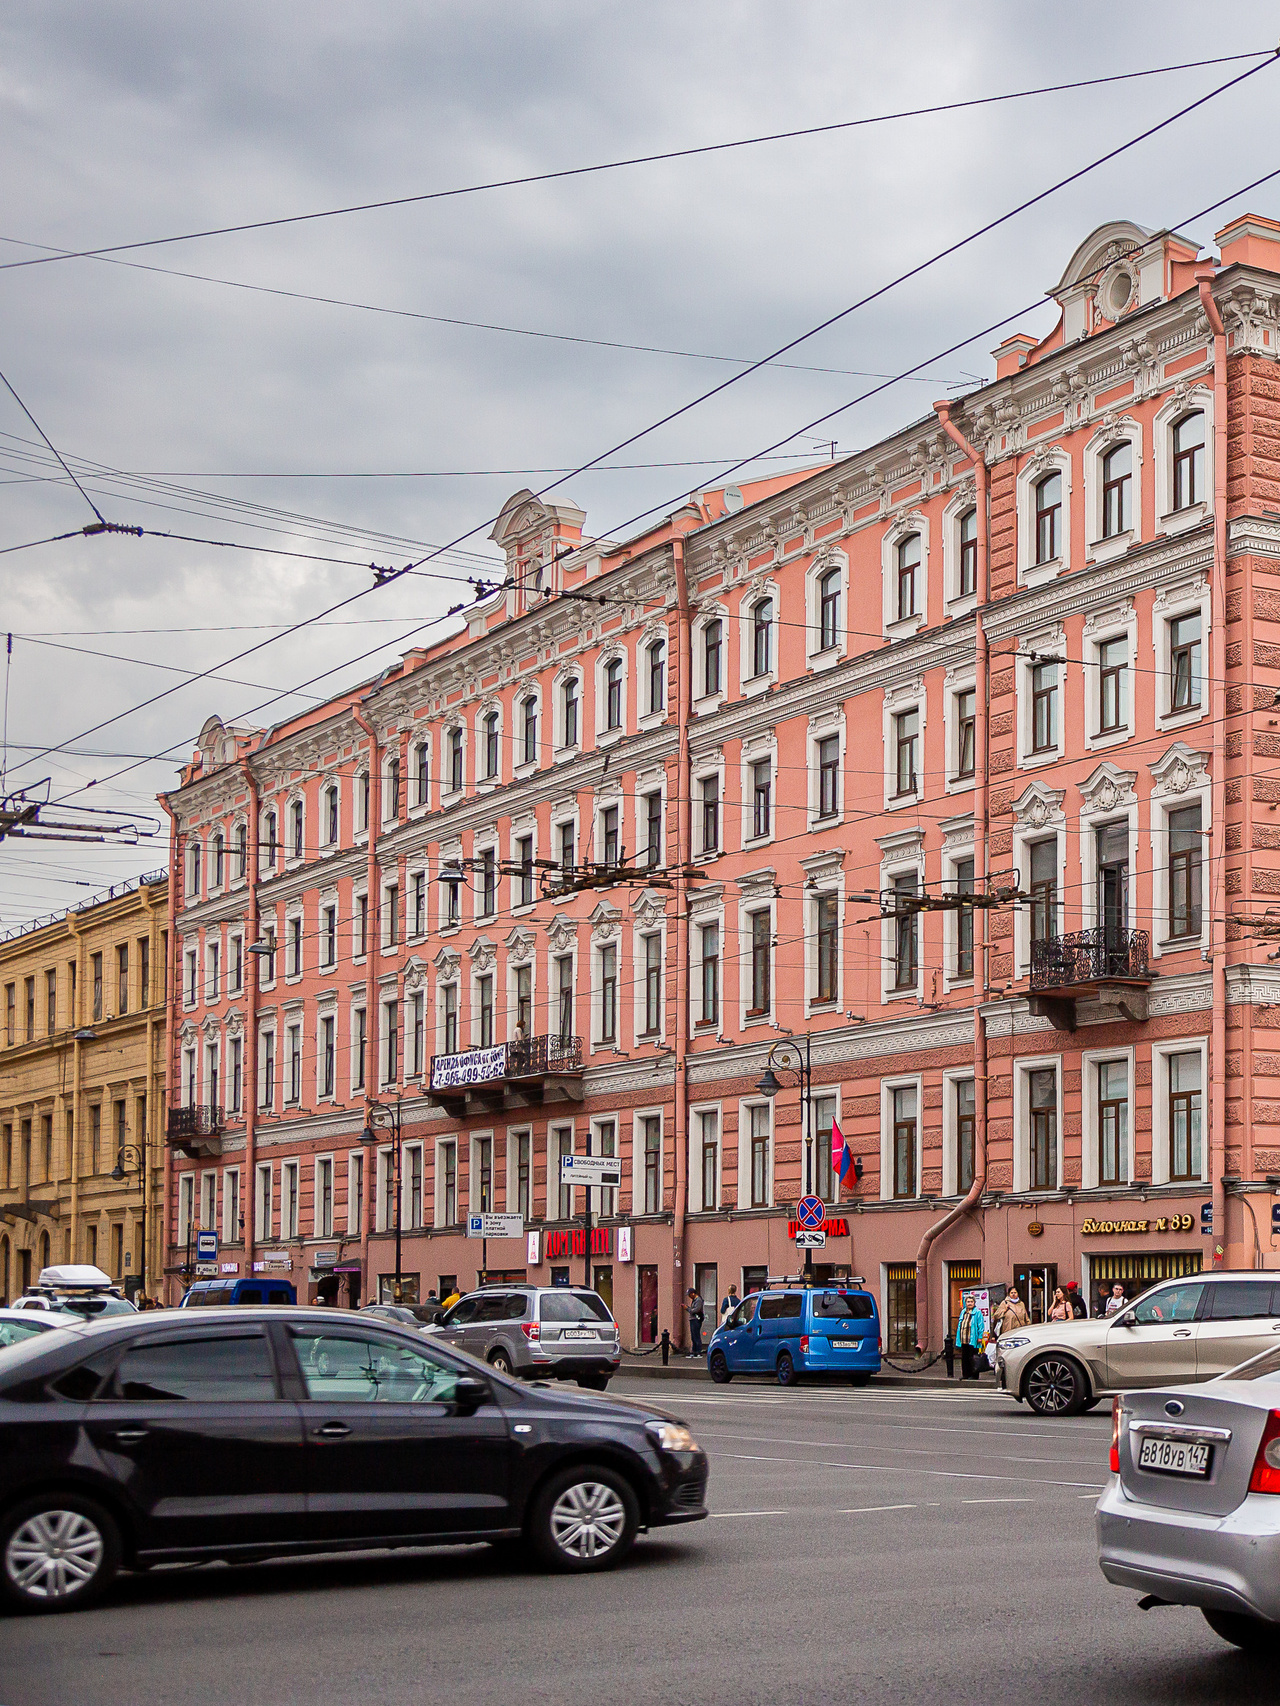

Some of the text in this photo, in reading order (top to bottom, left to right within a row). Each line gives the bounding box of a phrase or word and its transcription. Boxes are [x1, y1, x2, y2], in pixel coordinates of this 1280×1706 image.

[574, 1159, 605, 1167] СВОБОДНЫХ
[1080, 1218, 1148, 1233] Булочная
[1171, 1214, 1193, 1230] 89
[545, 1231, 569, 1259] ДОМ
[1143, 1442, 1206, 1467] В818УВ 147
